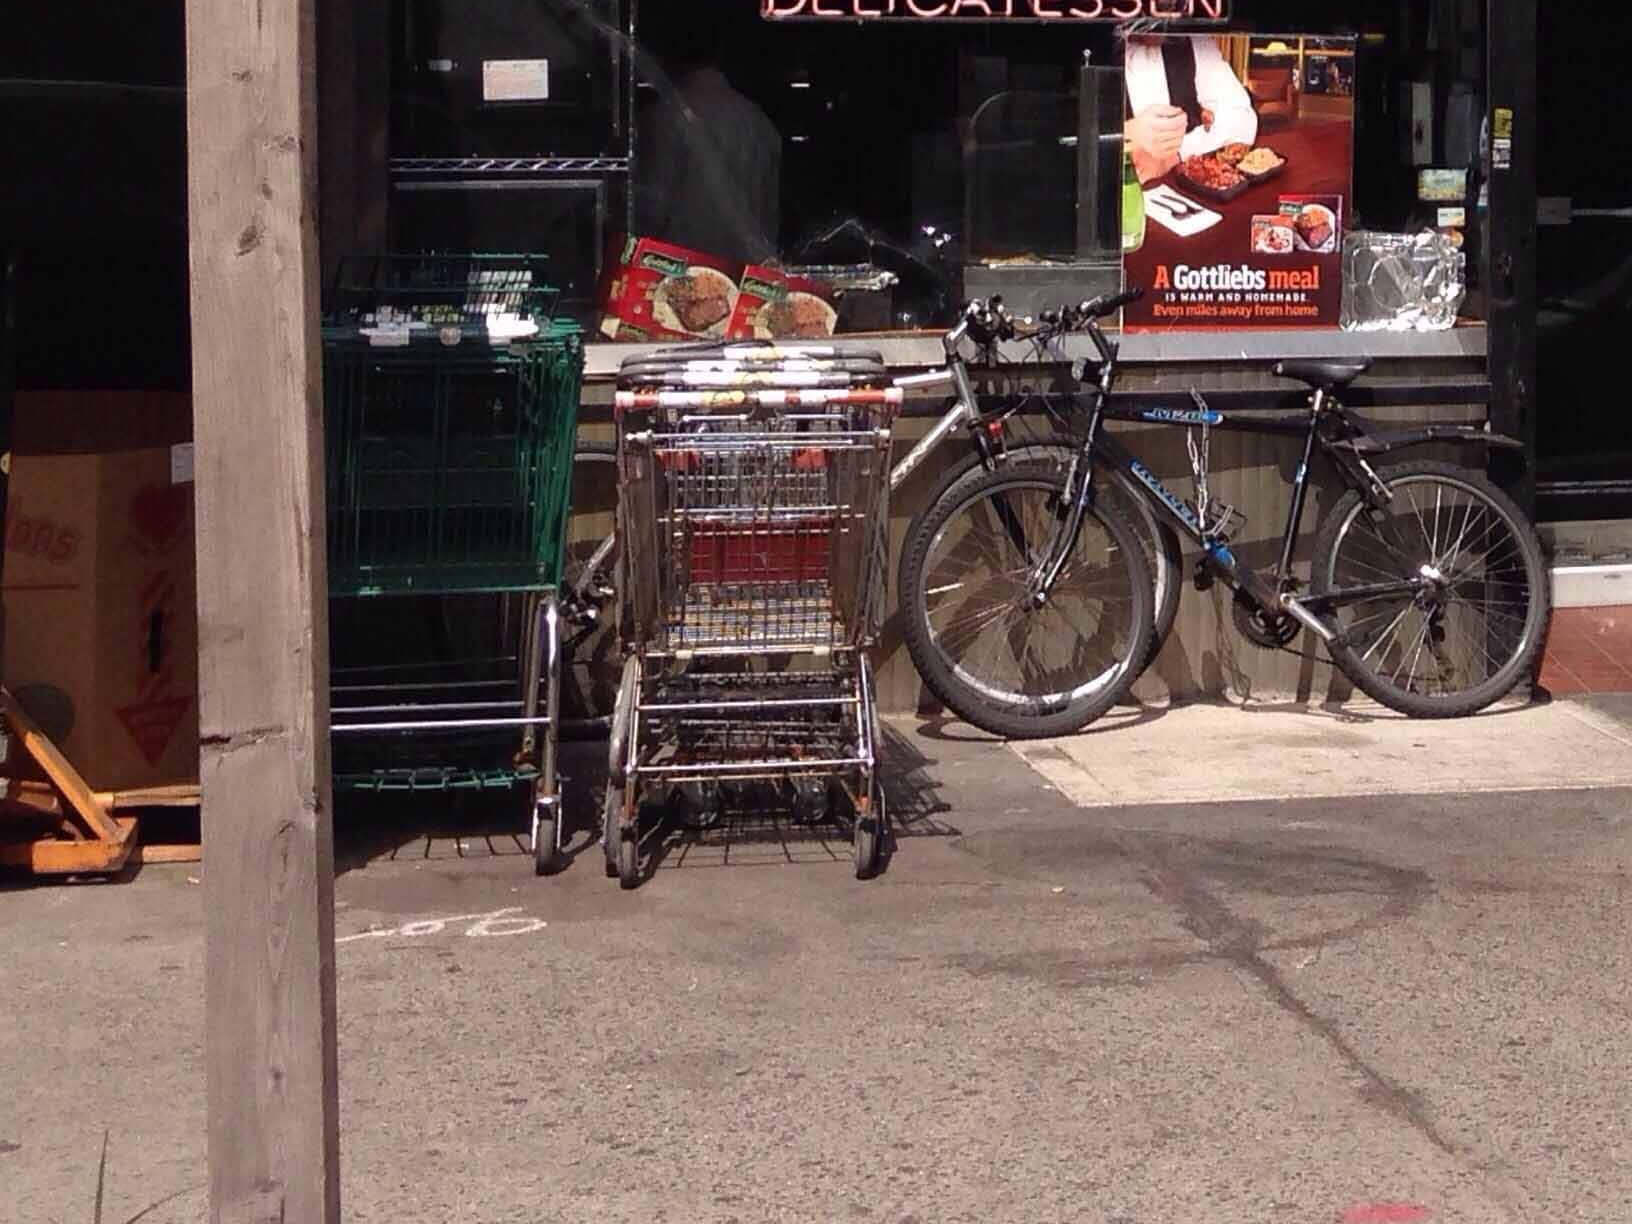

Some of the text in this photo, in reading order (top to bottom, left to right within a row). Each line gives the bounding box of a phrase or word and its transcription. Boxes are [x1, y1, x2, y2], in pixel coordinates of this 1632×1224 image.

[1153, 263, 1319, 291] A Gottliebs meal
[1180, 292, 1214, 302] WARM
[1217, 292, 1241, 302] AND
[1153, 304, 1319, 319] Even miles away from home
